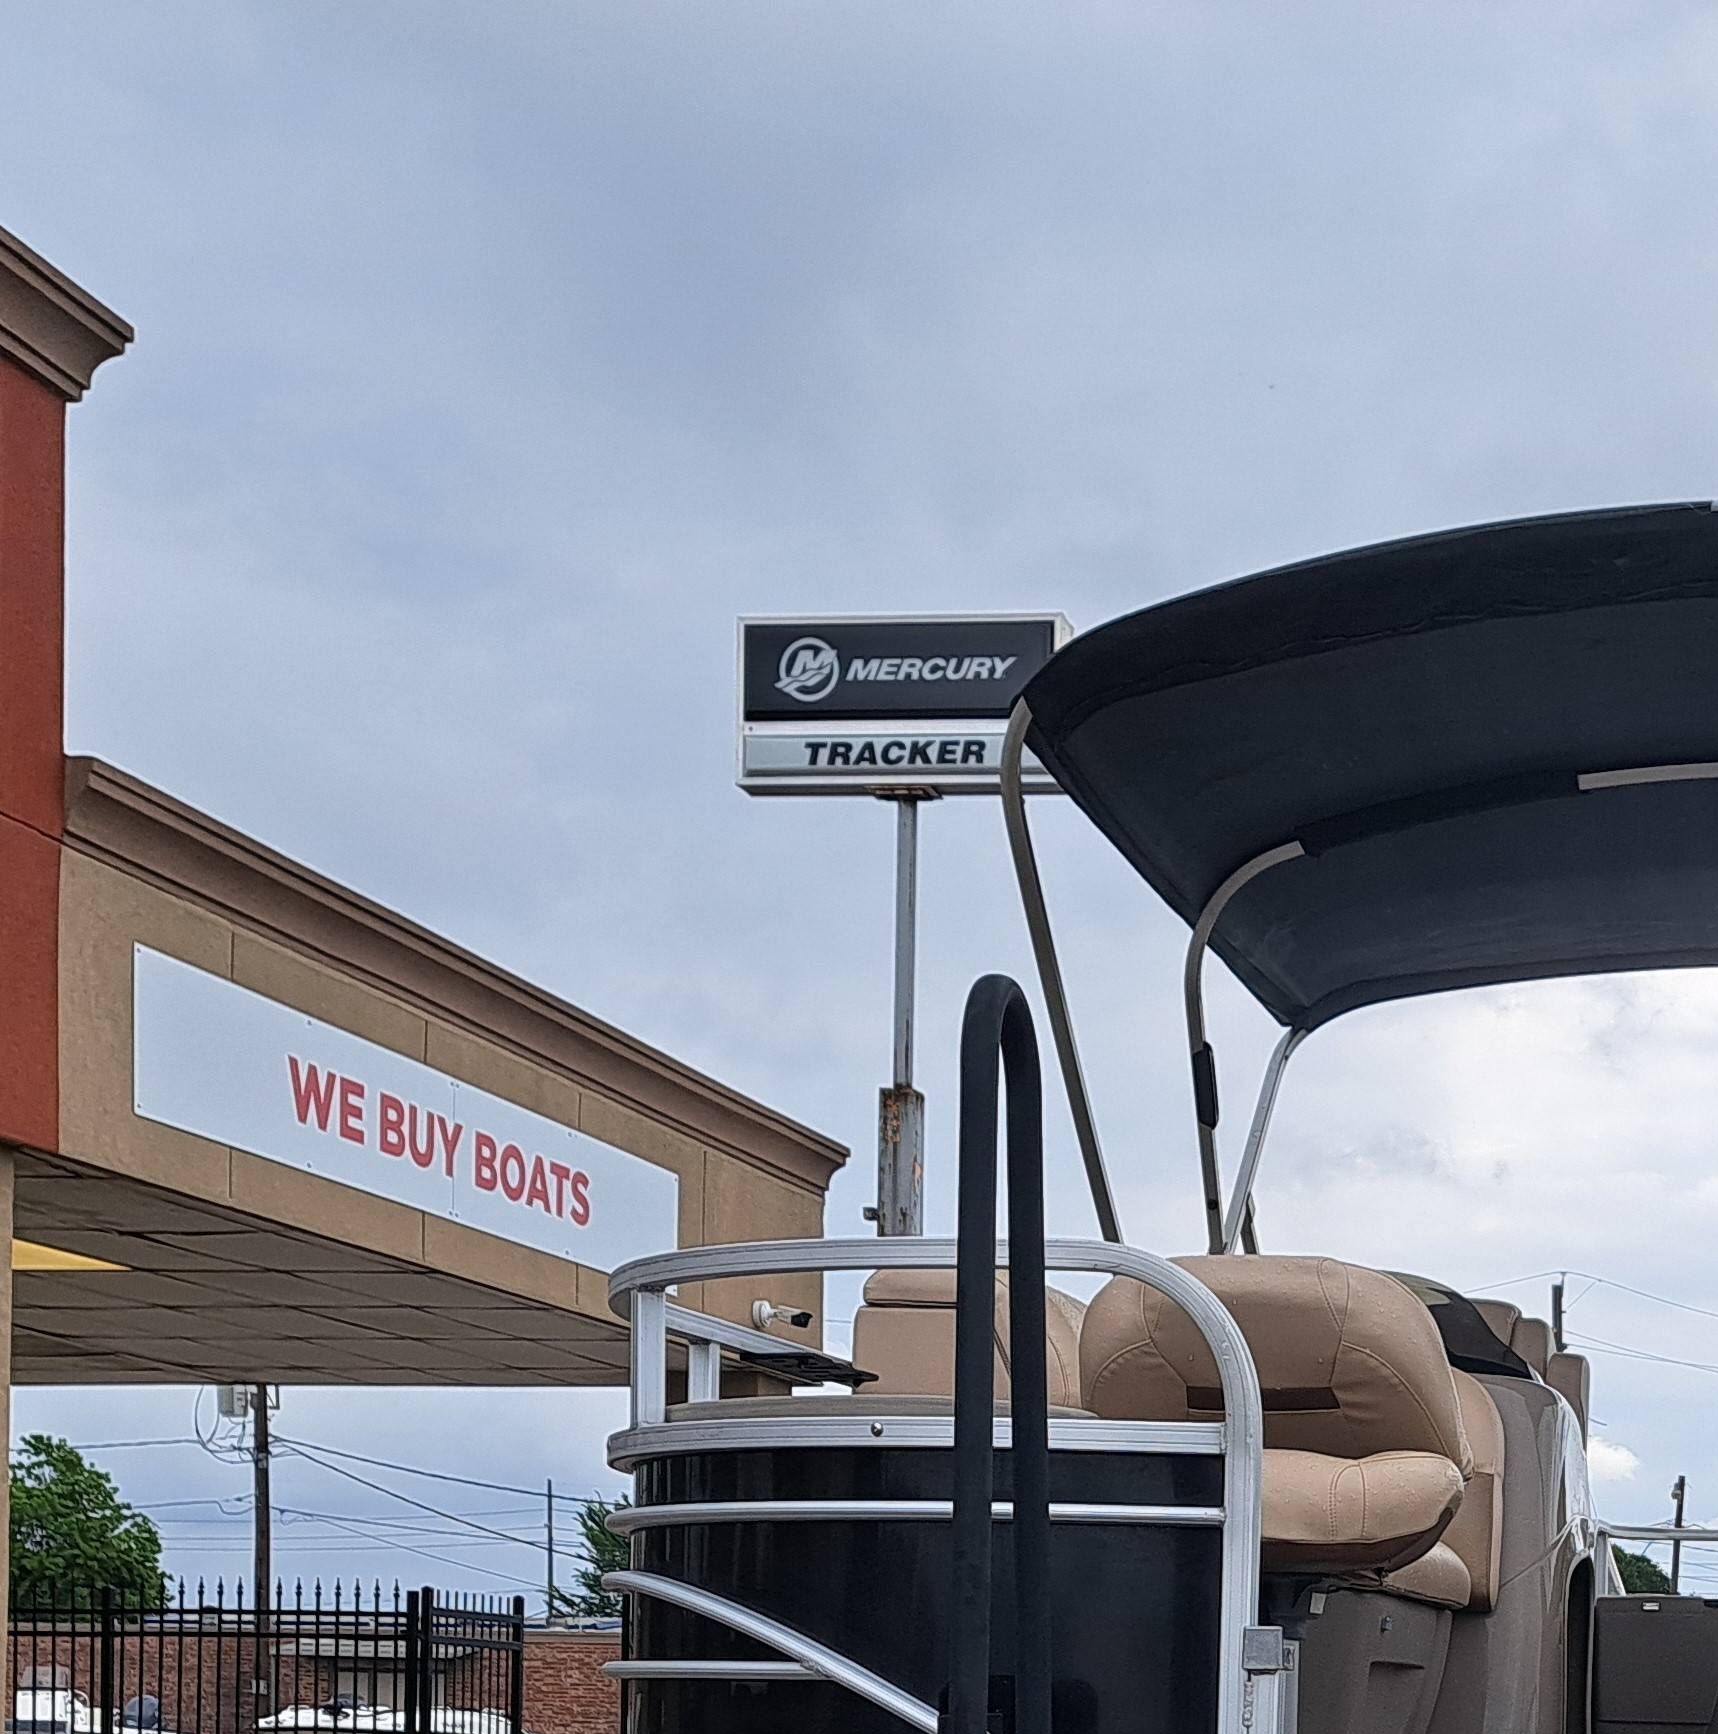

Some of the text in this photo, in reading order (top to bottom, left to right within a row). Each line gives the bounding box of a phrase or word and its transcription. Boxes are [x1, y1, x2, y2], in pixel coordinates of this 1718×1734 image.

[846, 656, 1017, 682] MERCURY
[804, 739, 987, 766] TRACKER
[287, 1054, 591, 1227] WE BUY BOATS
